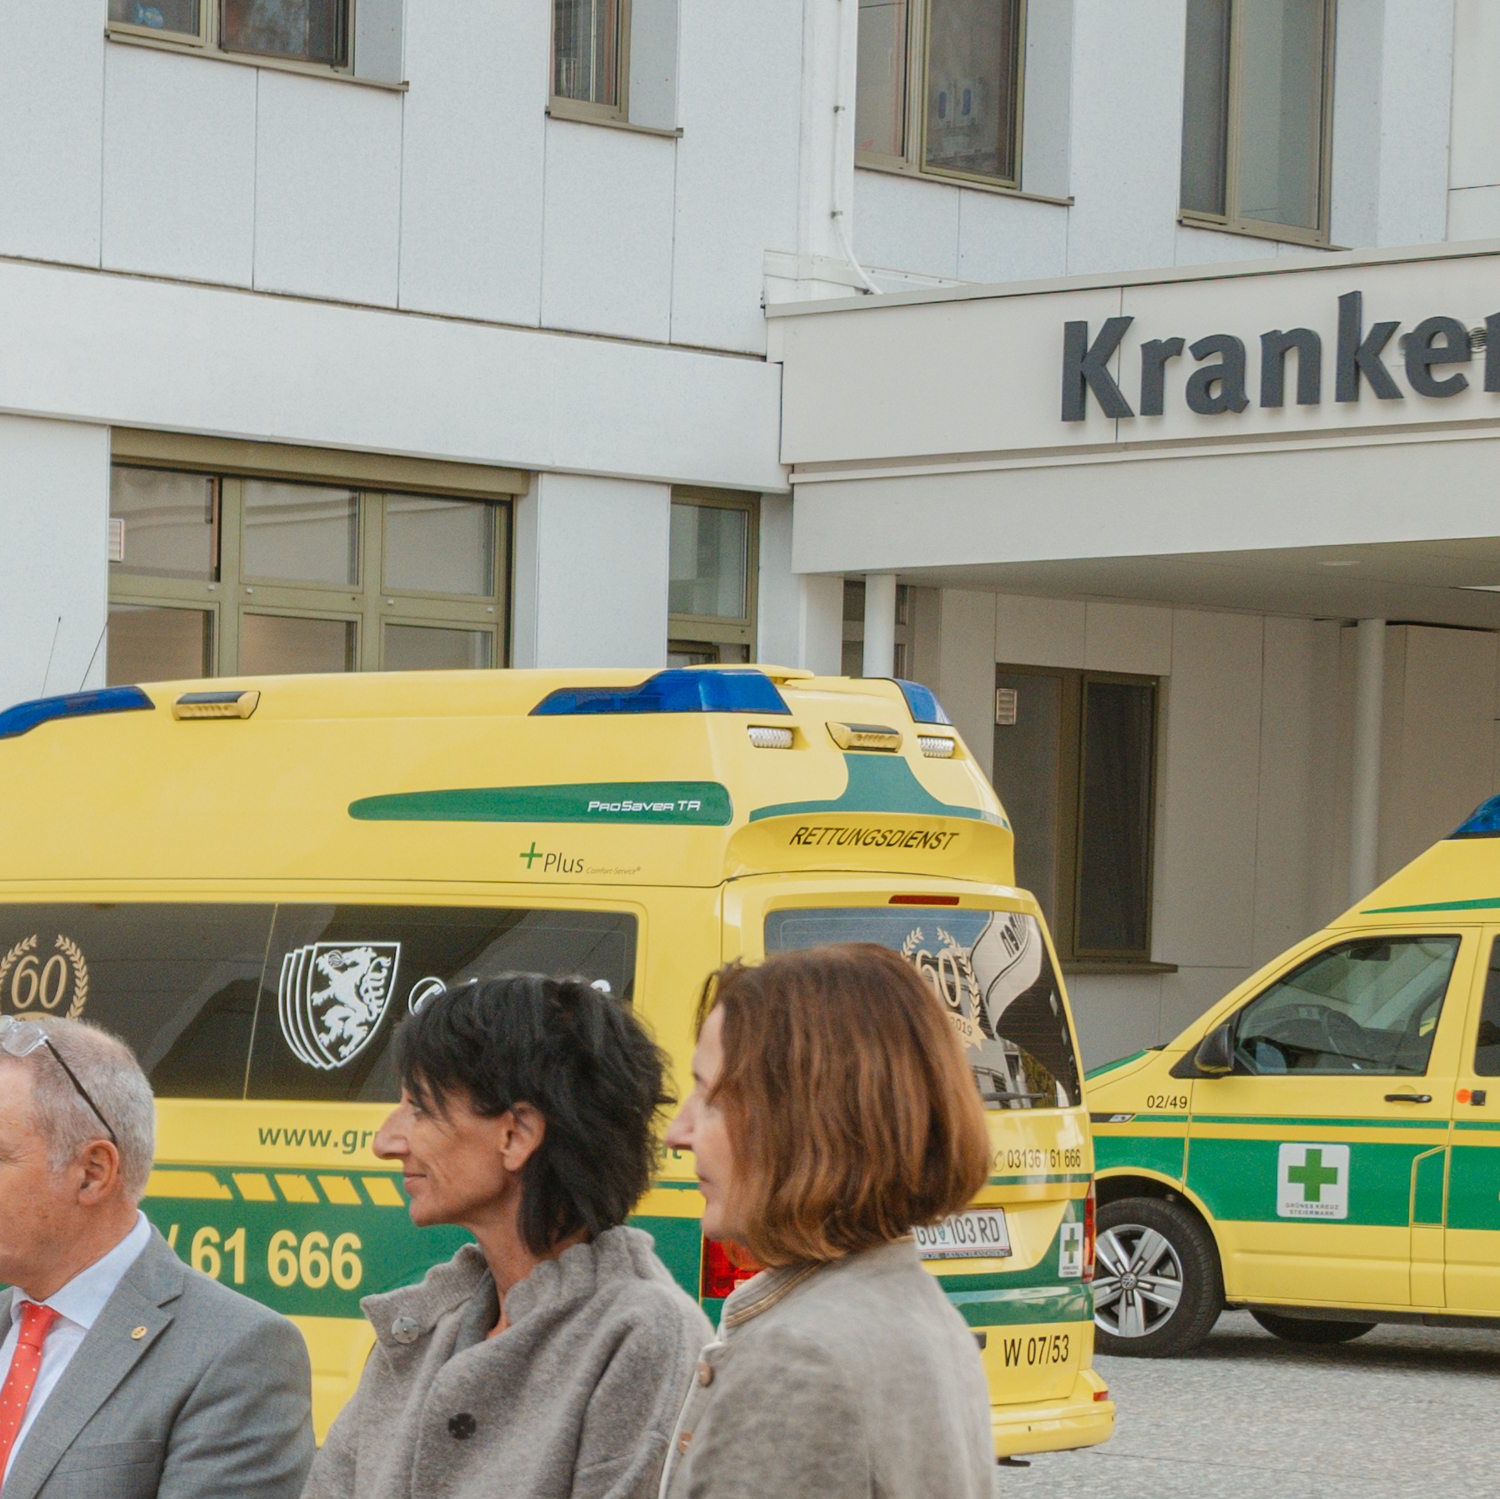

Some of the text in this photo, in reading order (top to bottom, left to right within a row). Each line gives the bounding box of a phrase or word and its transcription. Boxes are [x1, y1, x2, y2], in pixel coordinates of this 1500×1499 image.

[1060, 290, 1500, 423] Kranke
[789, 826, 960, 850] RETTUNGSDIENST
[543, 852, 584, 873] Plus
[11, 955, 67, 1009] 60
[1146, 1095, 1188, 1109] 02/49
[257, 1127, 378, 1155] www.gr
[1007, 1149, 1041, 1168] 03136
[1050, 1148, 1061, 1168] 61
[1064, 1148, 1082, 1168] 666
[950, 1216, 977, 1245] 103
[977, 1215, 1001, 1244] RD
[191, 1226, 246, 1284] 61
[267, 1229, 363, 1291] 666
[1004, 1333, 1069, 1367] W 07/53
